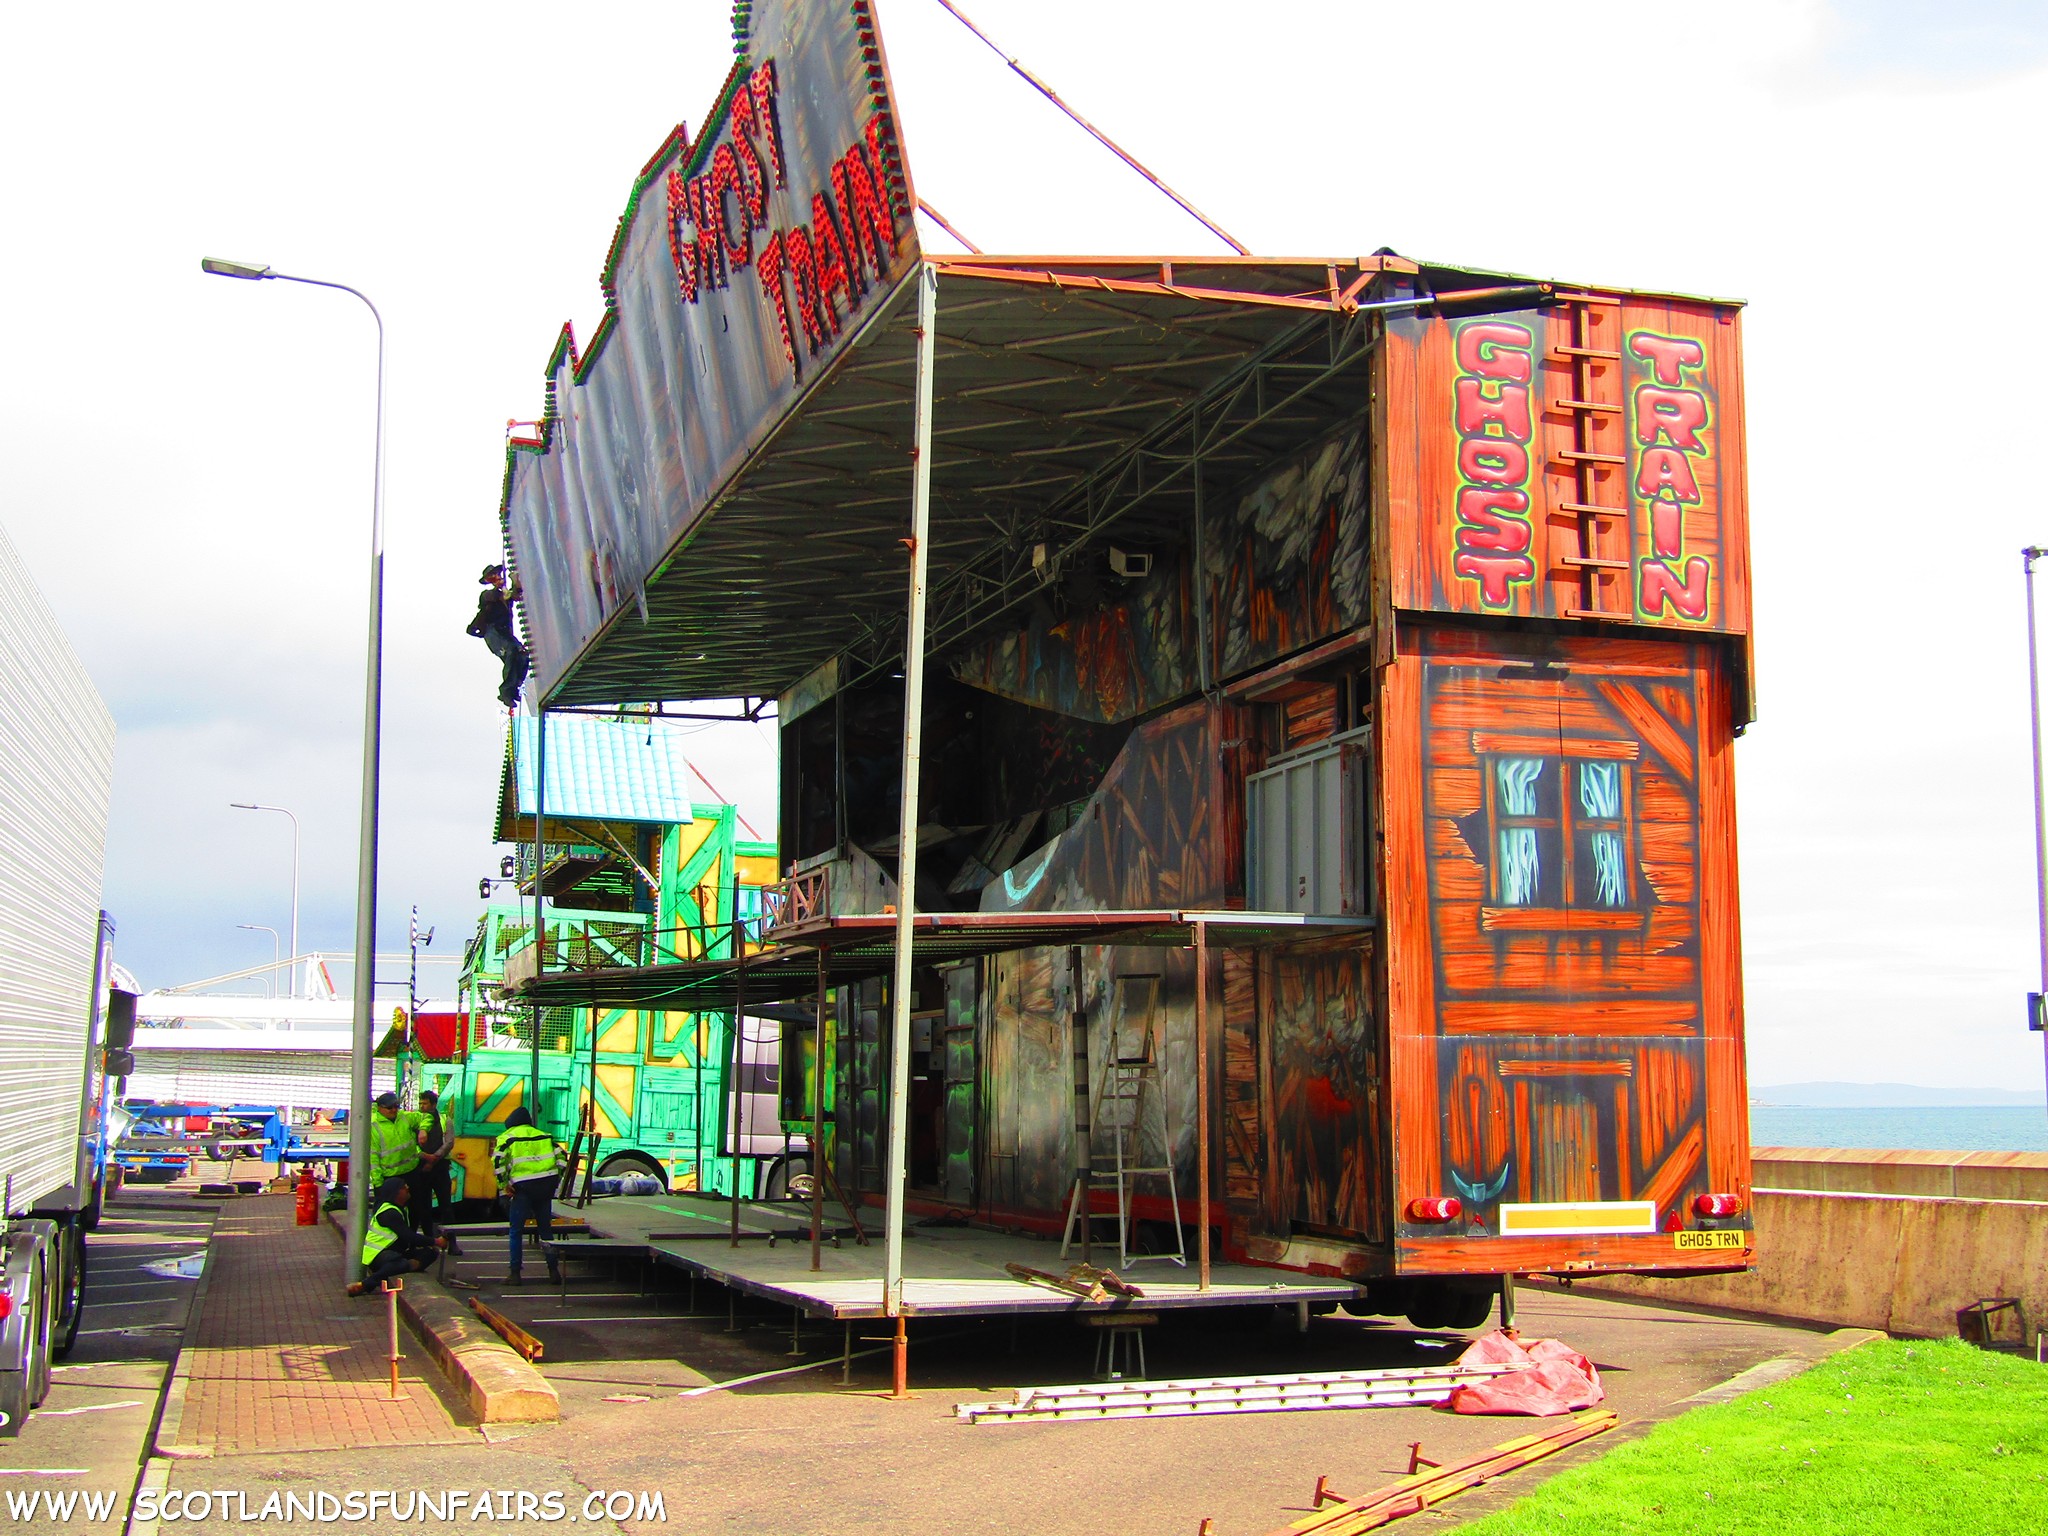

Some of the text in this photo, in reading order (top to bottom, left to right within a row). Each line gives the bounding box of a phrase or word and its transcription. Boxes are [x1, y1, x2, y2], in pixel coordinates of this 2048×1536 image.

[667, 58, 784, 303] GHOST
[757, 111, 897, 376] TRAIN
[1454, 321, 1535, 608] GHOST
[1628, 331, 1711, 621] TRAIN
[1716, 1232, 1740, 1246] TRN
